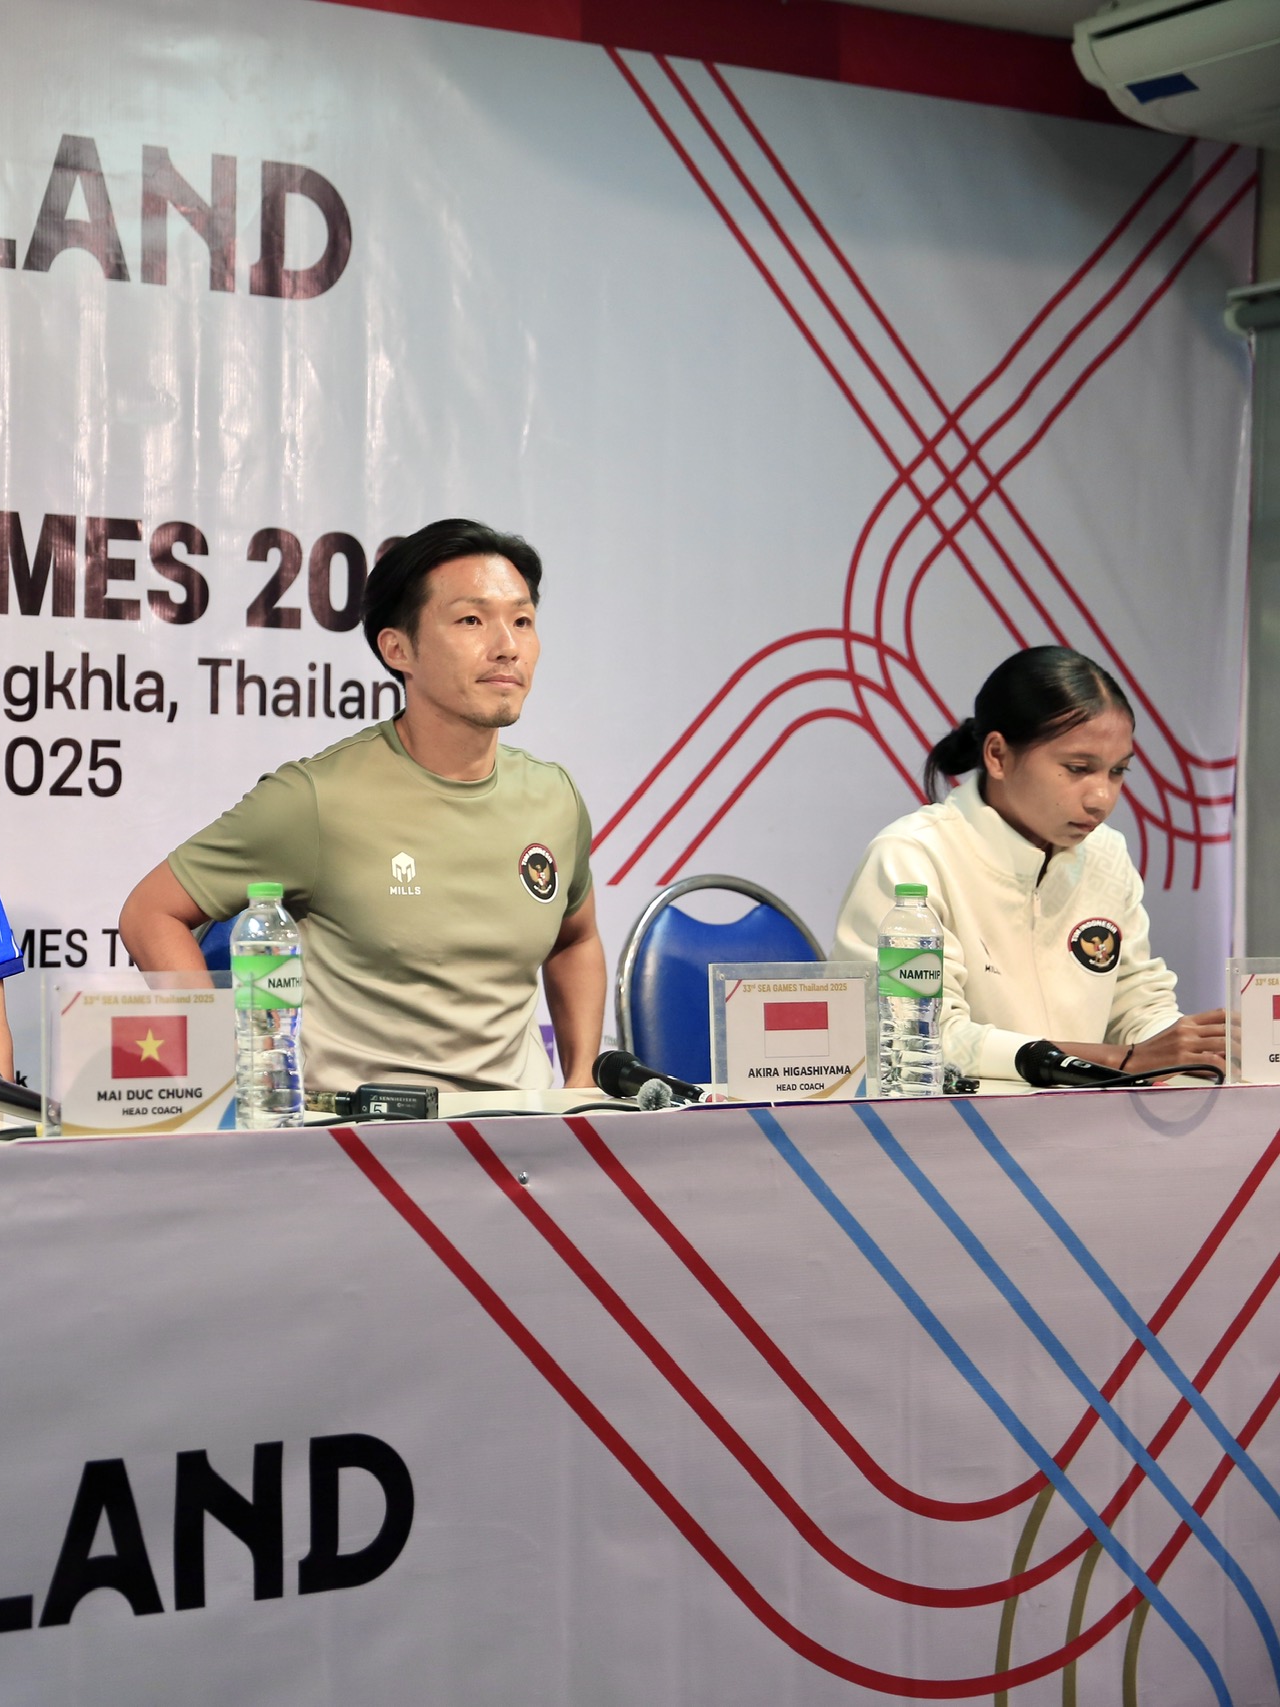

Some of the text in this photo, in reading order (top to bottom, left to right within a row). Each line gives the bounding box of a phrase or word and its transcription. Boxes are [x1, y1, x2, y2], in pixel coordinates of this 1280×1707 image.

[245, 527, 410, 632] 20
[197, 657, 405, 720] Thailan
[389, 886, 421, 896] MILLS
[899, 969, 941, 980] NAMTHIP
[757, 983, 771, 992] SEA
[773, 983, 797, 992] GAMES
[799, 982, 829, 992] Thailand
[830, 982, 848, 991] 2025
[154, 993, 191, 1004] Thailand
[193, 993, 215, 1004] 2025
[748, 1065, 852, 1078] AKIRA HIGASHIYAMA
[776, 1082, 825, 1092] HEAD COACH
[97, 1087, 203, 1101] MAI DUC CHUNG
[122, 1105, 183, 1116] HEAD COACH
[373, 1103, 383, 1113] 5
